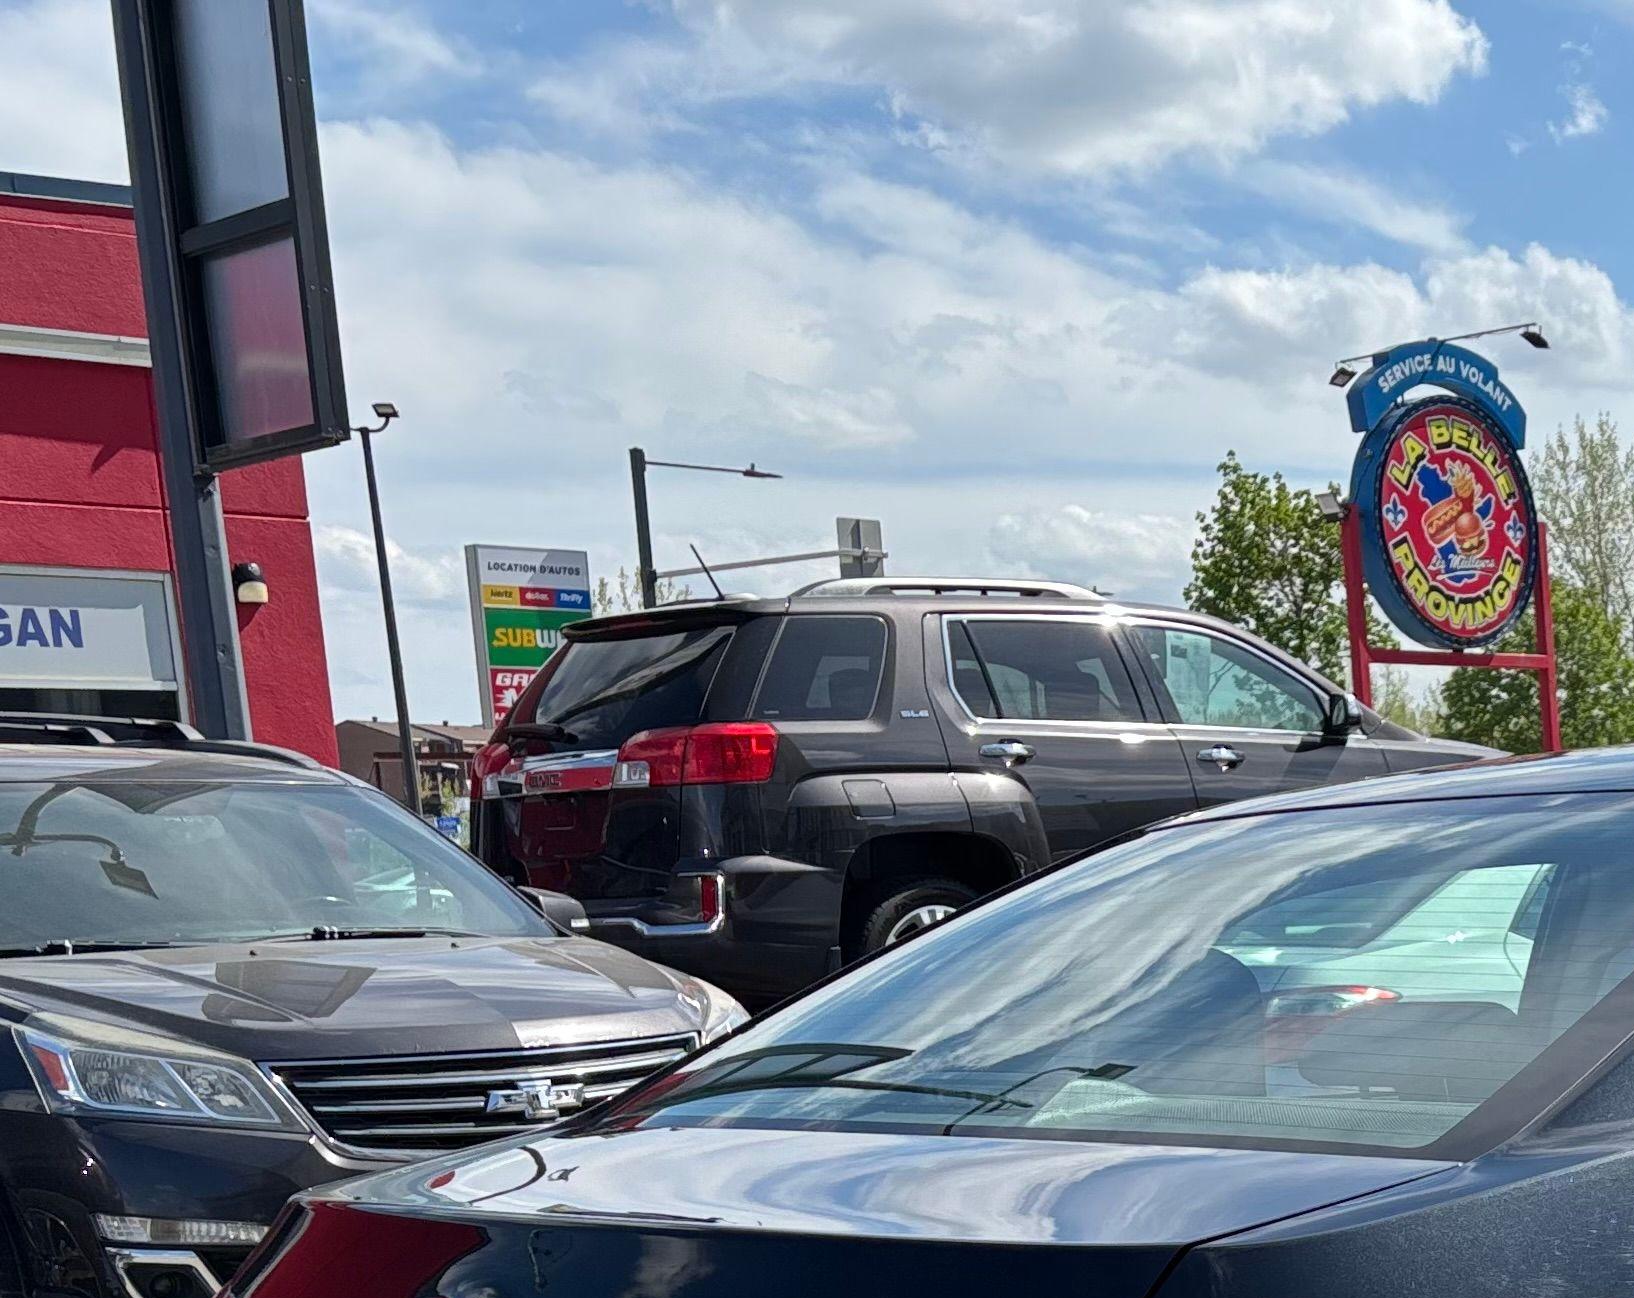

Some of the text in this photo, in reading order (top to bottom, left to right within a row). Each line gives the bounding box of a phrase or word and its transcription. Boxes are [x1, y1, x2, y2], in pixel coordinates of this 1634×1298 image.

[1377, 353, 1512, 411] SERVICE AU VOLANT
[1388, 416, 1519, 509] LA BELLE
[487, 561, 581, 577] LOCATION D'AUTOS
[1389, 533, 1523, 627] PROVINCE
[492, 627, 563, 649] SUBW
[495, 672, 536, 687] GA
